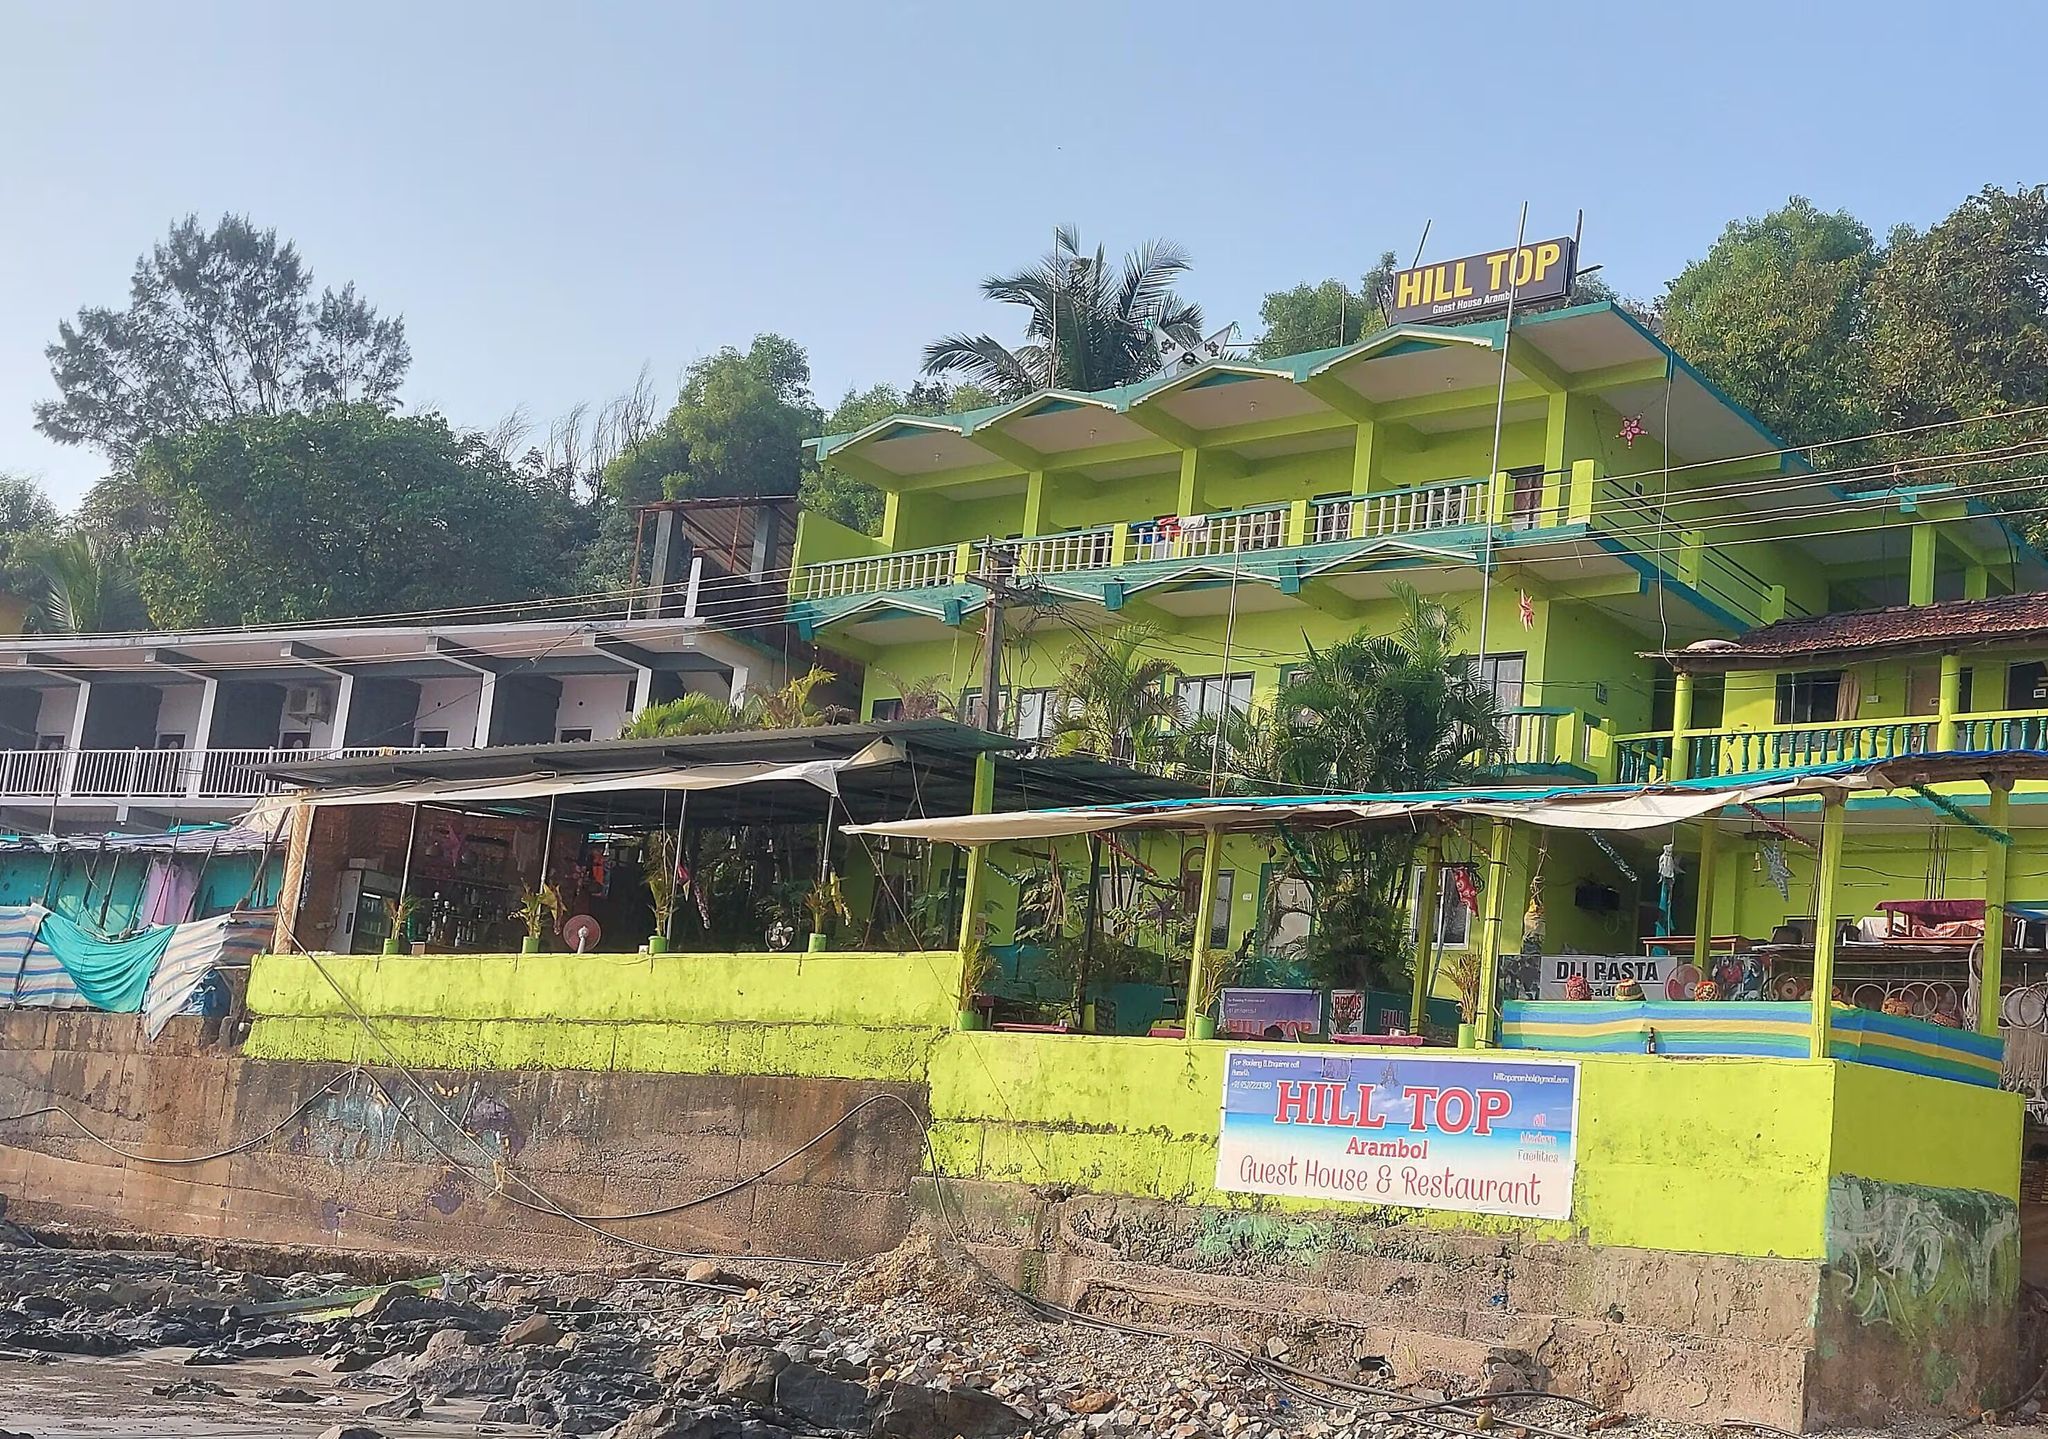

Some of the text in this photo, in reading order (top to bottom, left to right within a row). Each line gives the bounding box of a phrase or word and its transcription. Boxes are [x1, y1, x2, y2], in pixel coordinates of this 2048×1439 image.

[1397, 243, 1561, 309] HILL TOP
[1432, 288, 1519, 315] Guest House Arambl
[1232, 1058, 1242, 1067] For
[1274, 1080, 1513, 1137] HILL TOP
[1346, 1135, 1428, 1160] Arambol
[1520, 1130, 1557, 1145] Modern
[1517, 1148, 1559, 1163] Facilities
[1240, 1154, 1541, 1206] Guest House & Restaurant
